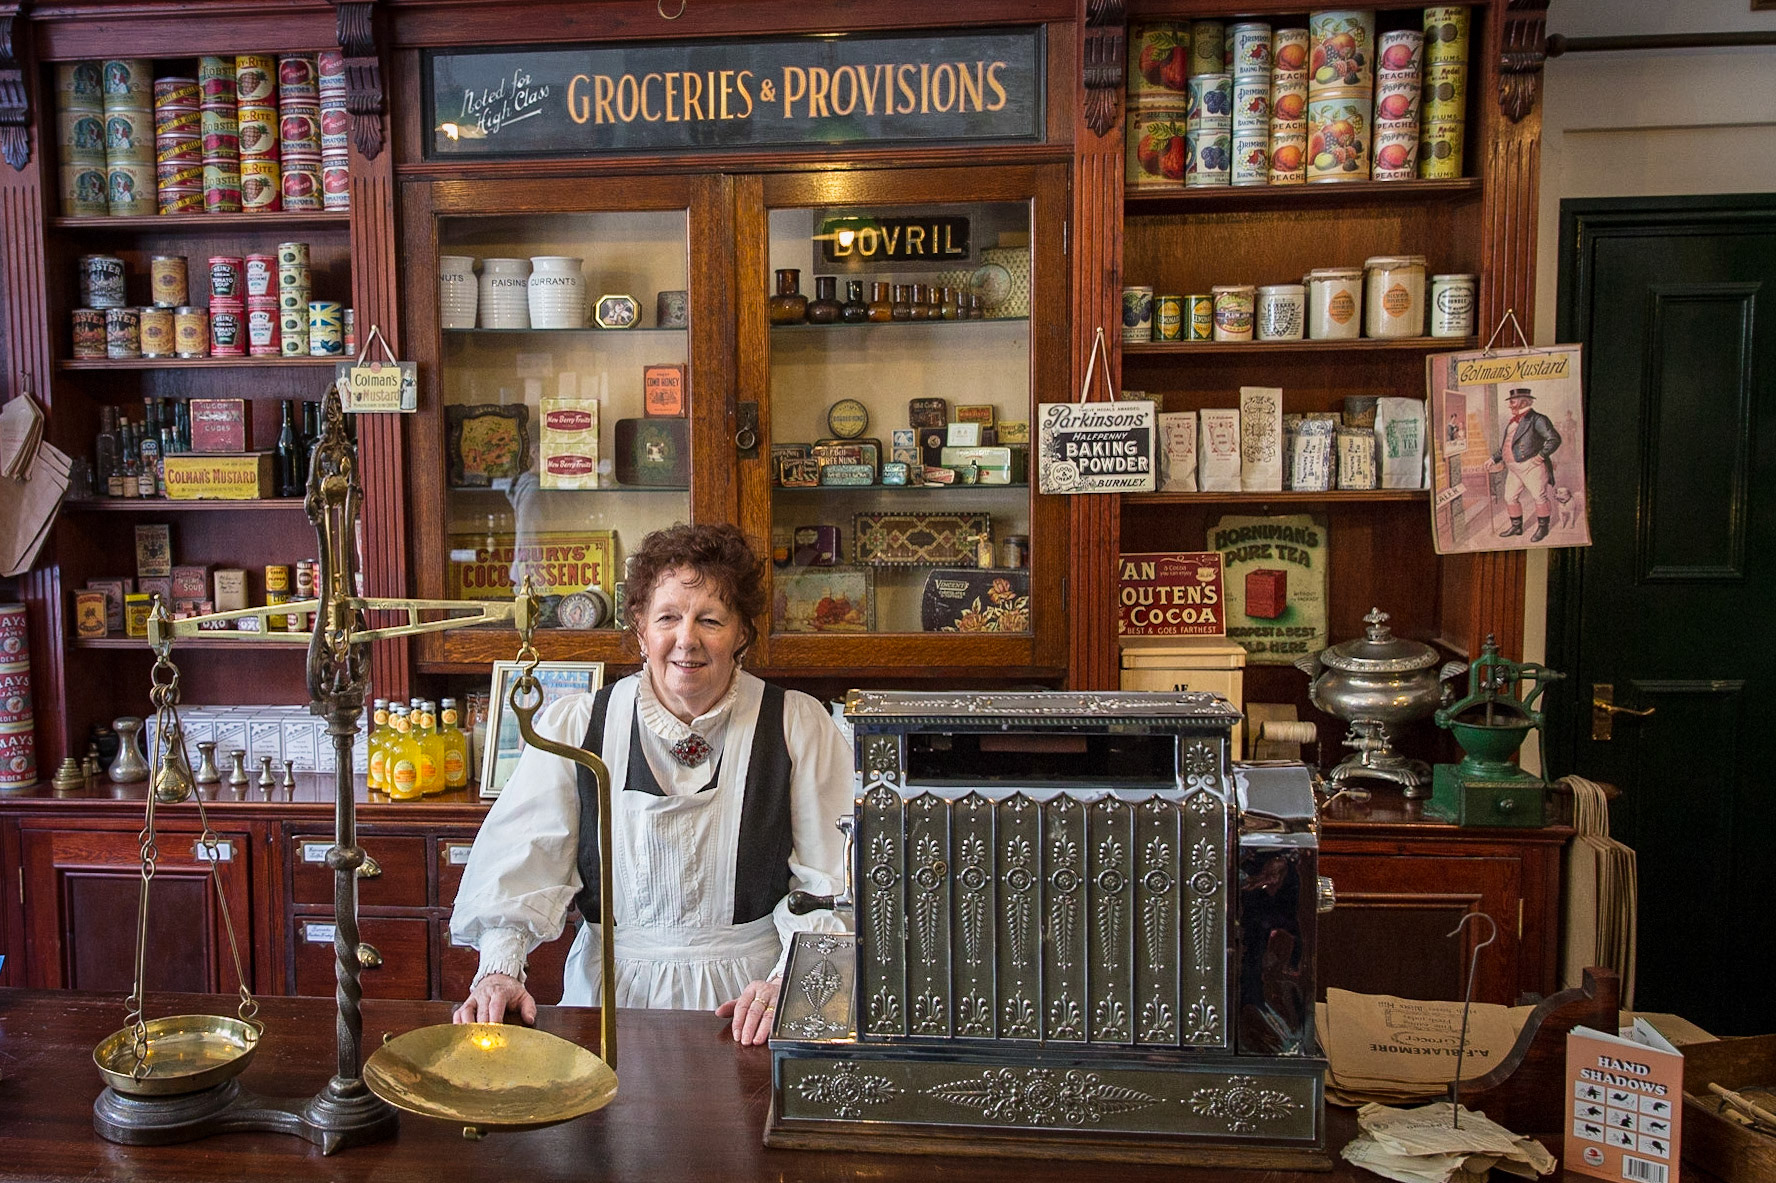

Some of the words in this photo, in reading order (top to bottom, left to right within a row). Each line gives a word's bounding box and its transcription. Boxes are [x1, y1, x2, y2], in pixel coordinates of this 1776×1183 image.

[461, 78, 504, 117] Noted
[510, 68, 532, 99] for
[567, 70, 753, 124] GROCERIES
[760, 79, 776, 102] &
[782, 61, 1008, 118] PROVISIONS
[475, 107, 511, 135] High
[514, 84, 549, 111] Class
[834, 224, 962, 257] BOVRIL
[491, 278, 527, 288] RAISINS
[530, 277, 577, 287] CURRANTS
[1460, 361, 1511, 383] Colman's
[1510, 357, 1568, 380] Mustard
[355, 374, 398, 387] Colman's
[363, 389, 400, 402] Mustard
[559, 414, 576, 425] Berry
[575, 414, 591, 424] Fruits
[1042, 404, 1149, 431] Parkinsons'
[1072, 432, 1128, 441] HALFPENNY
[1066, 440, 1138, 458] BAKING
[560, 459, 576, 469] Berry
[576, 459, 592, 468] Fruits
[1079, 456, 1149, 473] POWDER
[168, 469, 211, 484] COLMAN'S
[213, 469, 257, 484] MUSTARD
[1097, 479, 1146, 488] BURNLEY.
[1215, 524, 1319, 550] HORNIMAN'S
[1224, 544, 1273, 568] PURE
[1275, 544, 1312, 568] TEA
[463, 564, 516, 588] COCOA
[525, 562, 601, 586] ESSENCE
[1119, 582, 1218, 606] OUTEN'S
[202, 619, 226, 630] OXO
[1130, 606, 1217, 627] COCOA
[1157, 626, 1177, 634] GOES
[1180, 626, 1217, 634] FARTHEST
[1285, 627, 1316, 636] BEST
[1269, 641, 1308, 653] HERE
[1405, 1035, 1456, 1045] Grocer
[1369, 1043, 1459, 1056] BLAKEMORE
[1597, 1055, 1650, 1077] HAND
[1580, 1068, 1668, 1097] SHADOWS
